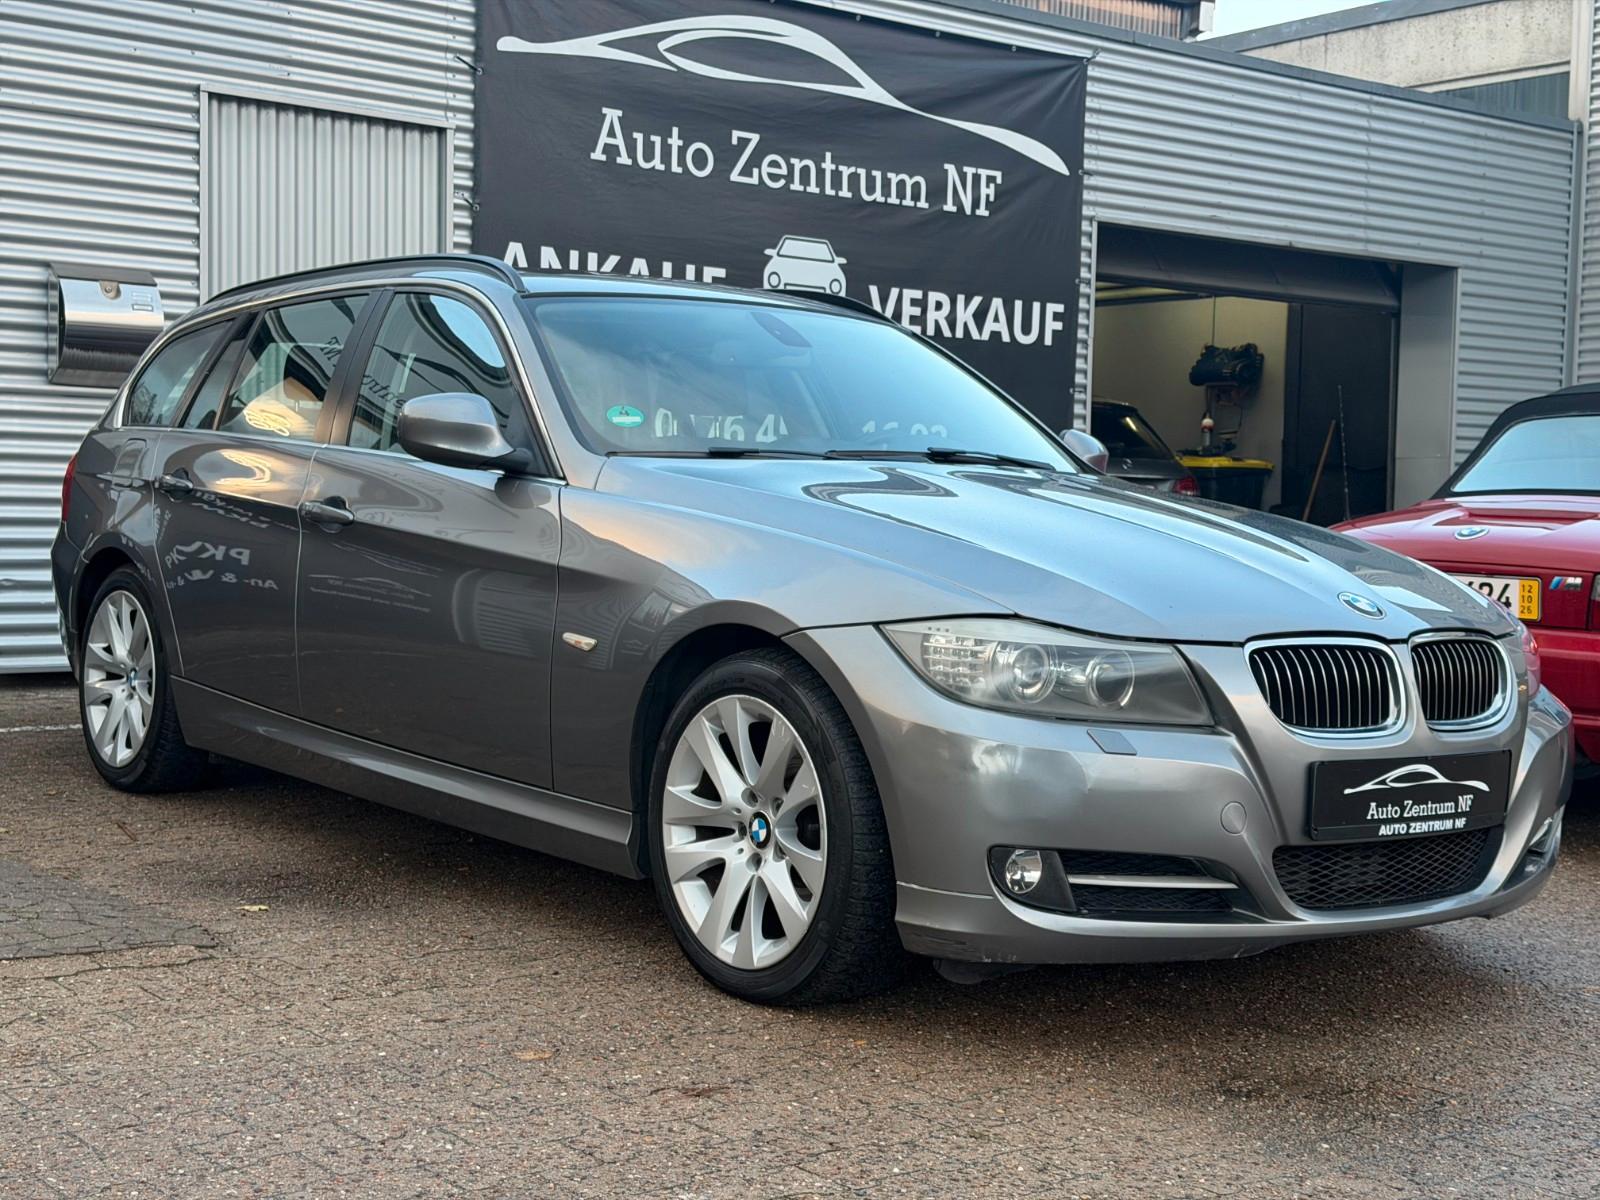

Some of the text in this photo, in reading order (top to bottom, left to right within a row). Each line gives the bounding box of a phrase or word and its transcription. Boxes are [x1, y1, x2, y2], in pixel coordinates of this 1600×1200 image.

[590, 106, 1002, 217] Auto Zentrum NF
[868, 284, 1065, 346] VERKAUF
[1521, 584, 1533, 593] 12
[1521, 595, 1533, 604] 10
[1366, 794, 1474, 820] Auto Zentrum NF
[1378, 817, 1467, 836] AUTO ZENTRUM NF
